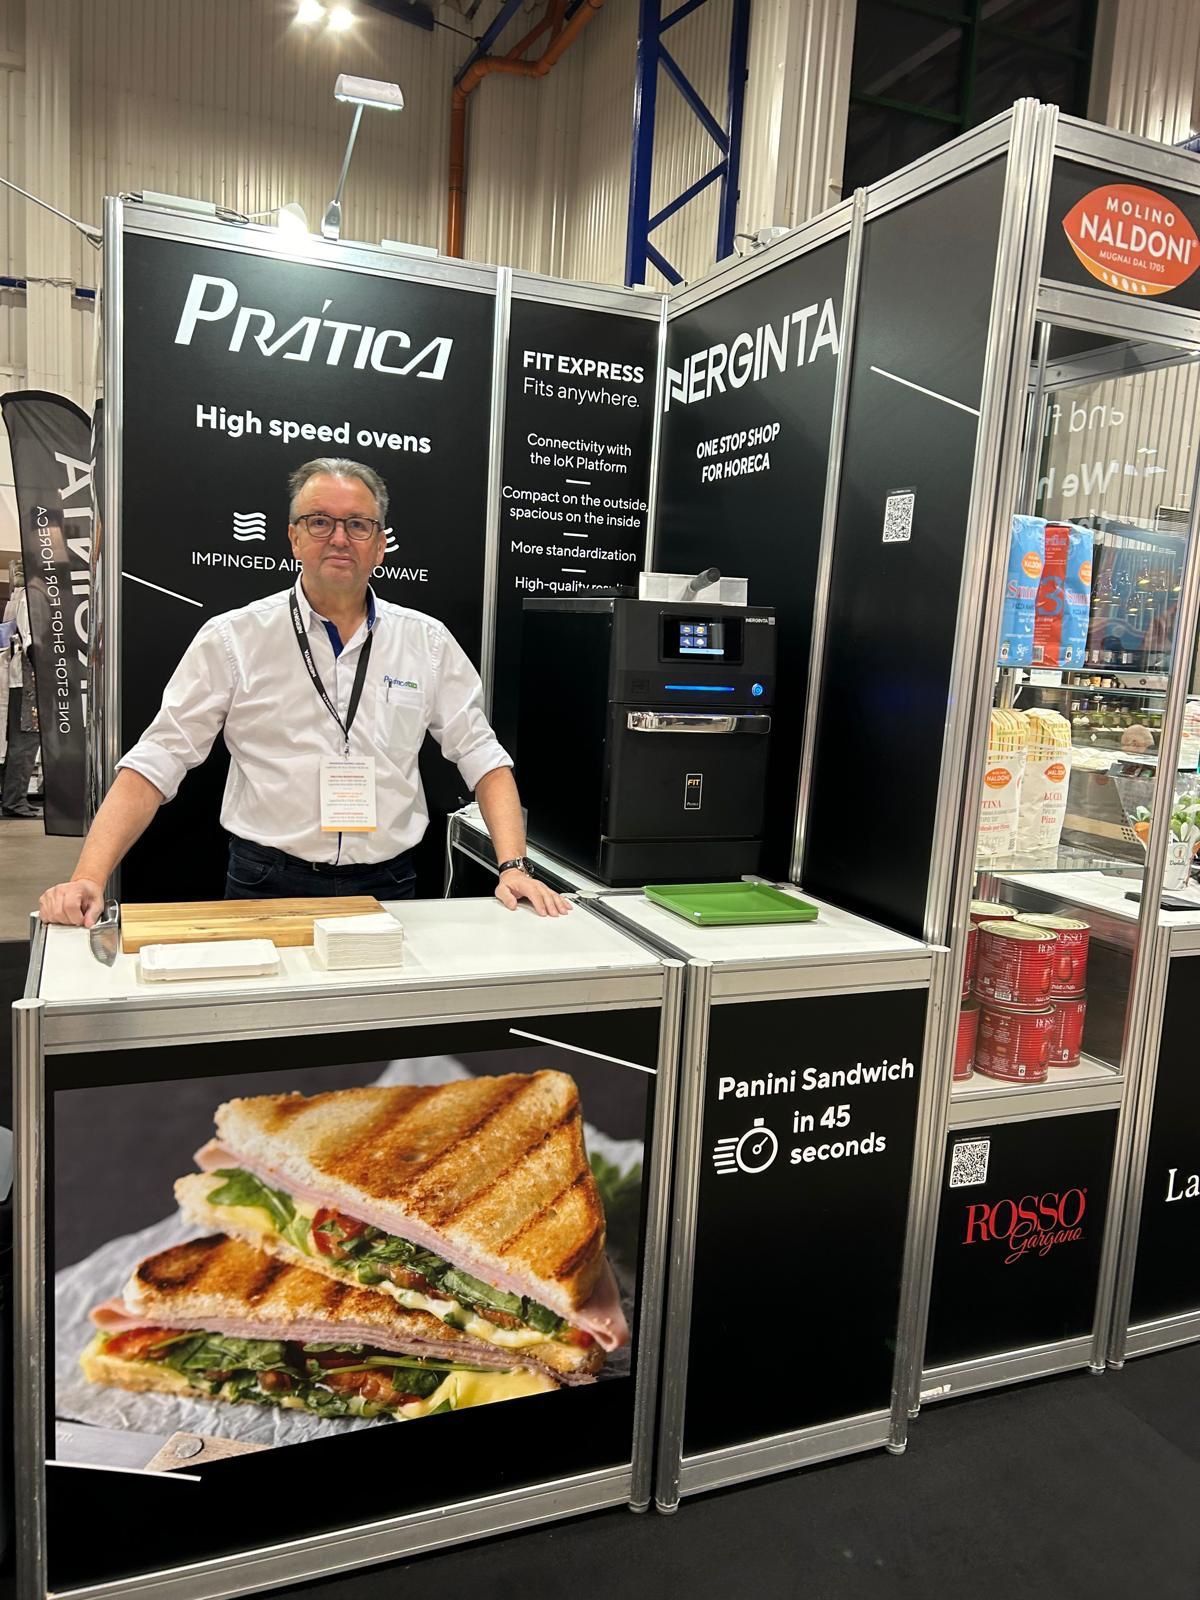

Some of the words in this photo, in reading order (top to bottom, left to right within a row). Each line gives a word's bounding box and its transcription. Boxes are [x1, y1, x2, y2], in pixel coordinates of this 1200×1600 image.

[1106, 196, 1175, 228] MOLINO
[1079, 211, 1192, 265] NALDONI
[1099, 250, 1131, 265] MUGNAI
[1132, 257, 1147, 269] DAL
[1149, 261, 1165, 273] 1705
[523, 350, 555, 371] FIT
[557, 355, 644, 383] EXPRESS
[664, 297, 840, 412] NERGINTA
[523, 377, 554, 396] Fits
[557, 387, 640, 408] anywhere.
[196, 404, 262, 434] High
[268, 419, 350, 444] speed
[356, 431, 432, 453] ovens
[696, 437, 720, 459] ONE
[719, 431, 747, 453] STOP
[747, 422, 781, 447] SHOP
[527, 433, 605, 456] Connectivity
[606, 444, 632, 457] with
[530, 452, 551, 465] the
[576, 457, 627, 474] Platform
[701, 462, 723, 483] FOR
[723, 452, 771, 478] HORECA
[502, 486, 560, 504] Compact
[562, 494, 578, 504] on
[580, 494, 600, 507] the
[509, 507, 563, 520] spacious
[565, 512, 581, 523] on
[584, 512, 604, 525] the
[606, 514, 641, 528] inside
[192, 551, 276, 570] IMPINGED
[511, 540, 544, 554] More
[545, 545, 637, 562] standardization
[718, 1069, 796, 1100] Panini
[801, 1057, 914, 1091] Sandwich
[793, 1110, 814, 1133] in
[820, 1104, 851, 1129] 45
[790, 1131, 887, 1165] seconds
[961, 1188, 1087, 1245] ROSSO
[1004, 1221, 1084, 1265] Gargano
